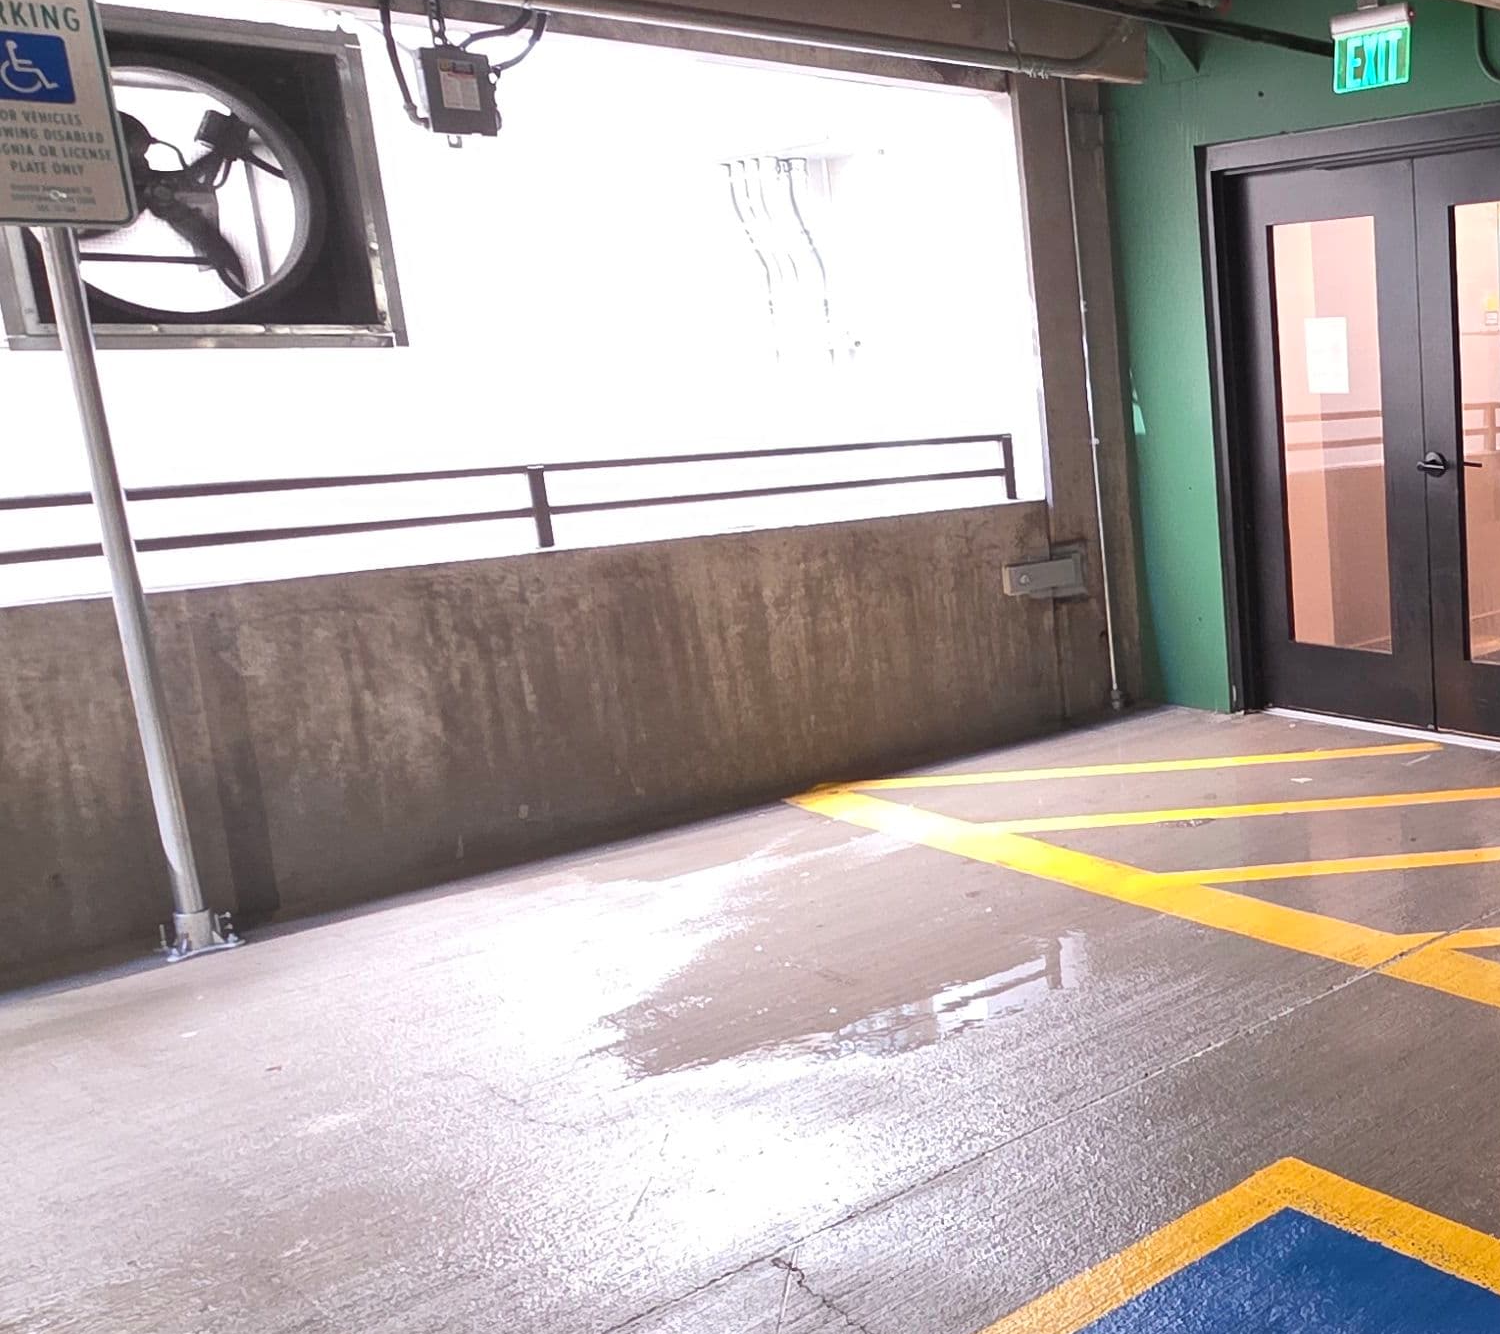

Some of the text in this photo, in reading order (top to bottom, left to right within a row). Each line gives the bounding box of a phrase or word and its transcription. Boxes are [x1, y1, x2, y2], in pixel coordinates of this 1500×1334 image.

[1346, 30, 1402, 87] EXIT
[22, 110, 82, 126] VEHICLES
[0, 126, 104, 144] WING DISABLED
[0, 143, 111, 161] GNIA OR LICENSE
[10, 159, 84, 176] PLATE ONLY
